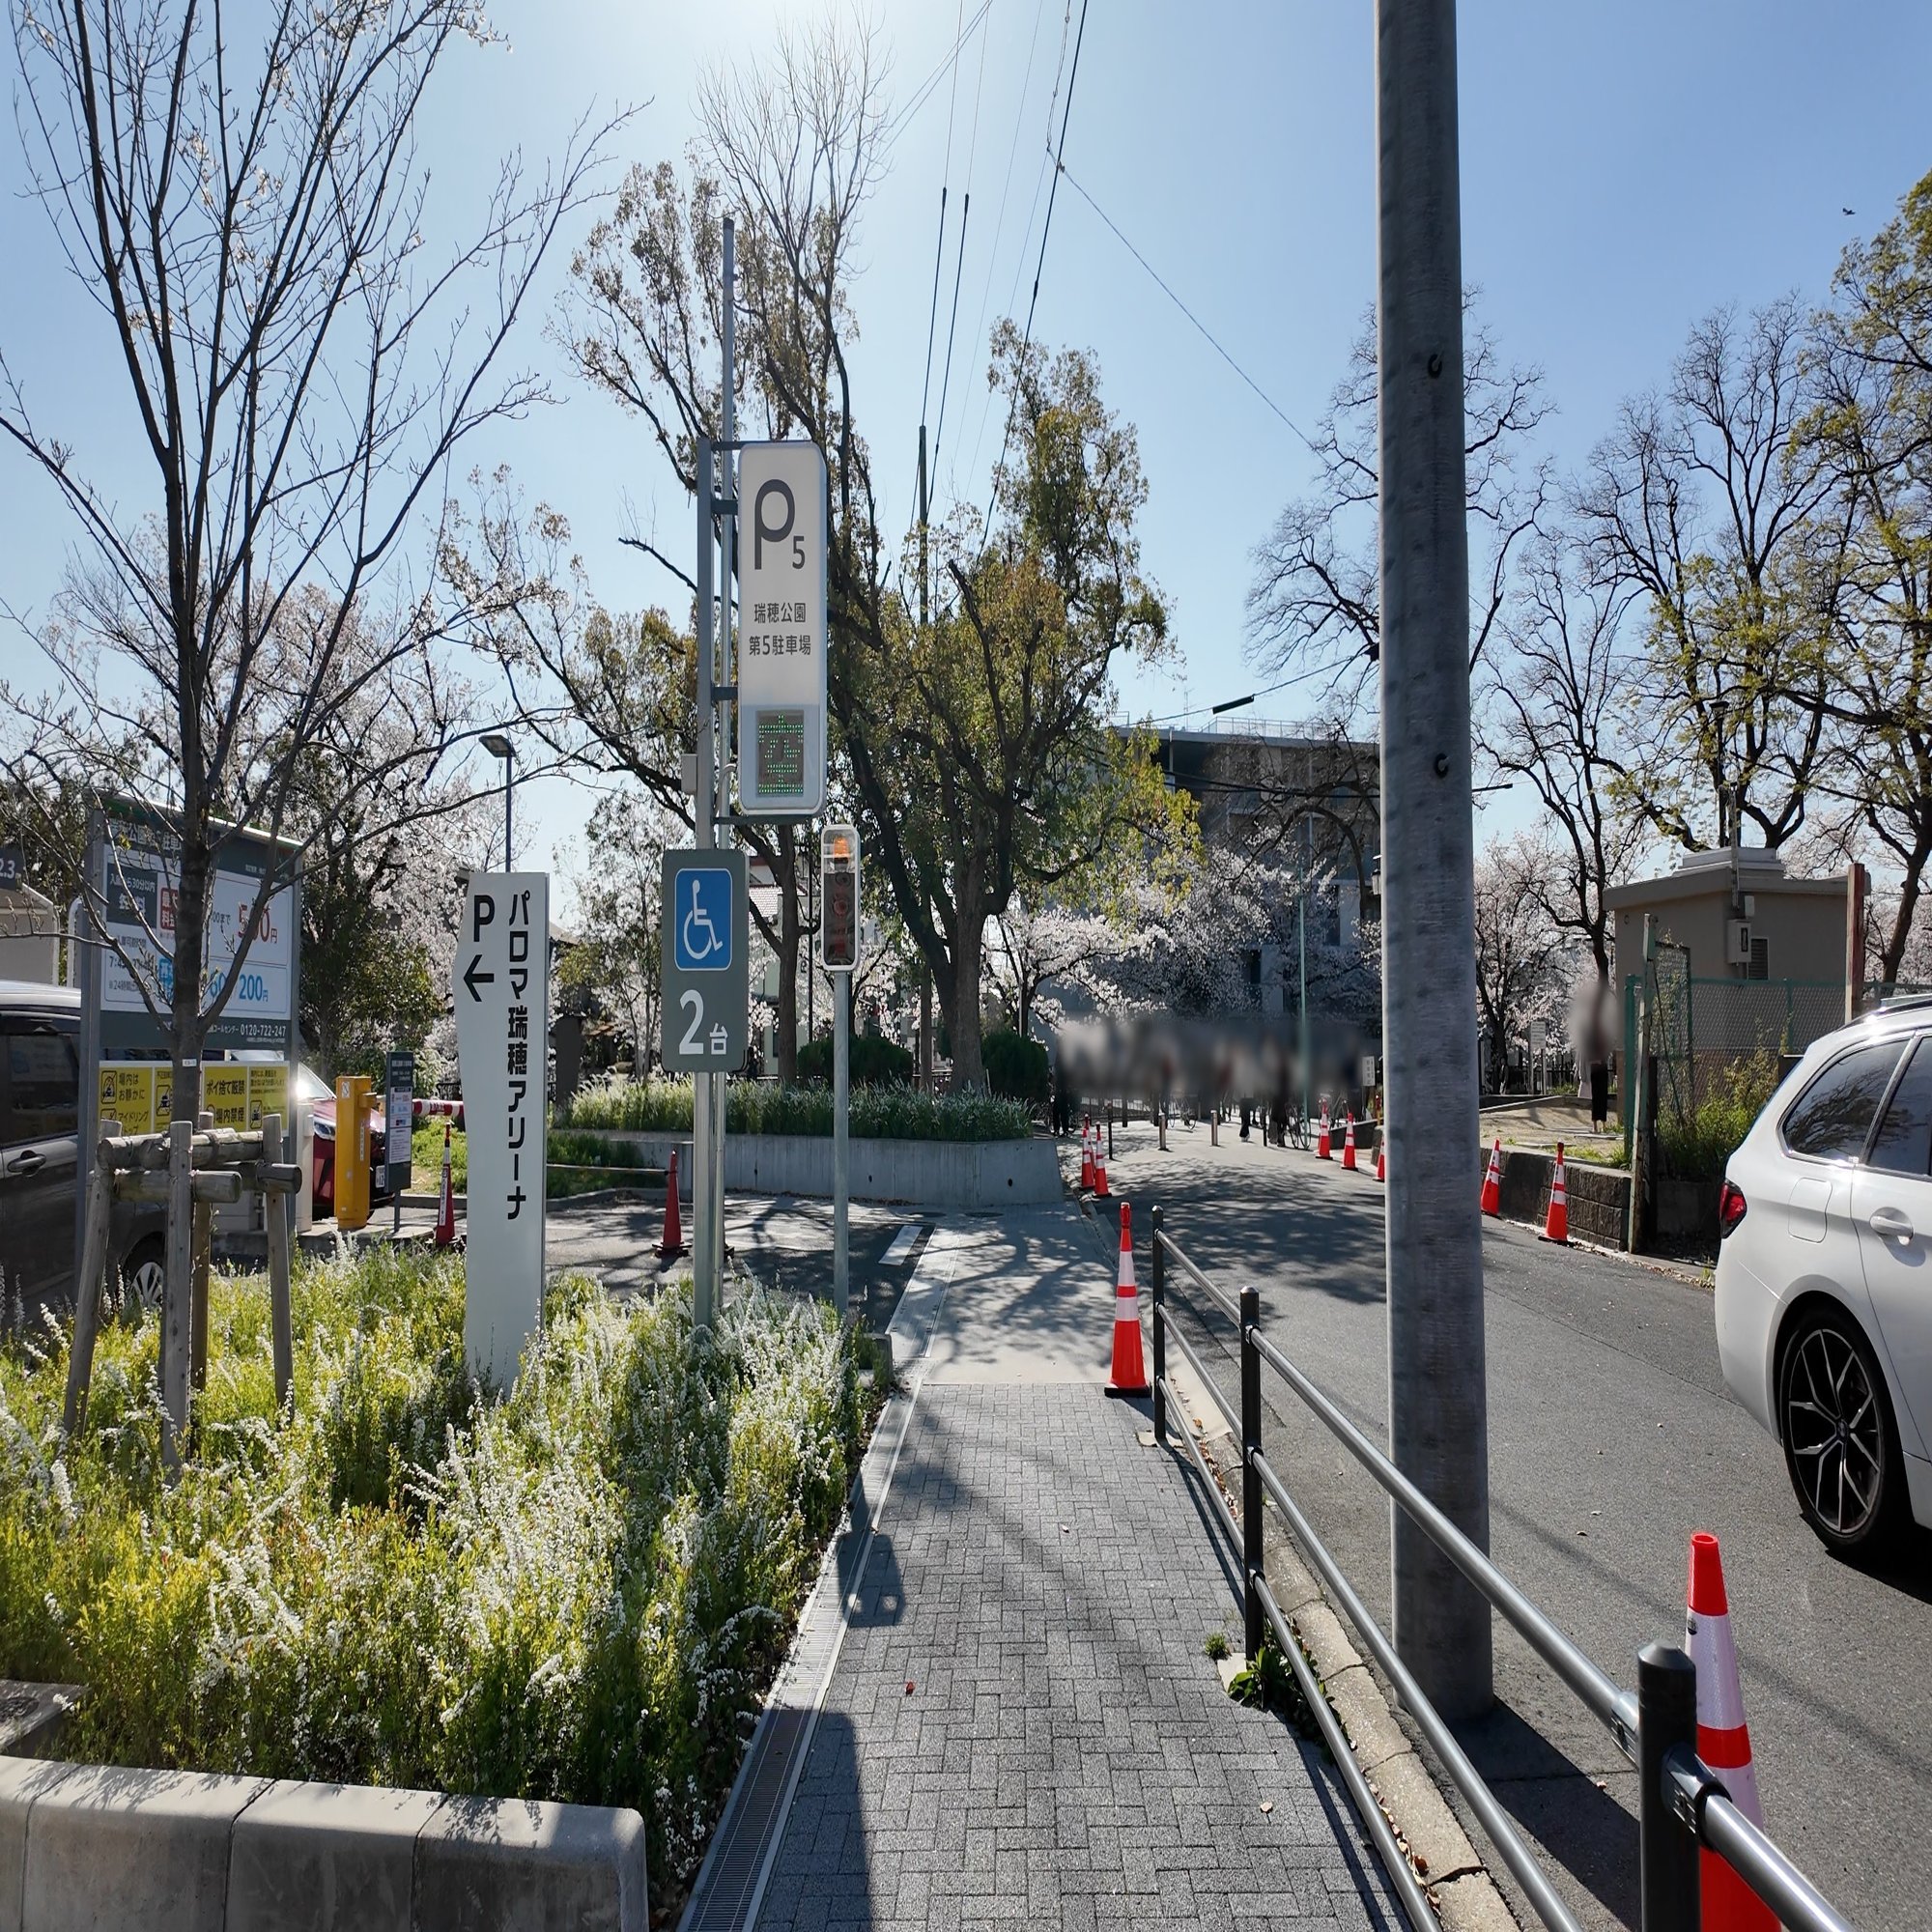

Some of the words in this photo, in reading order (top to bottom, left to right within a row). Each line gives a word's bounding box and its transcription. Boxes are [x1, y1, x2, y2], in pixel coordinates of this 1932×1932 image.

[753, 602, 807, 624] 瑞穂公園
[749, 635, 811, 657] 第5駐車場
[473, 895, 496, 942] P
[239, 974, 269, 1002] 200円
[240, 1024, 287, 1037] 0120-722-247
[679, 989, 728, 1055] 2台
[507, 890, 530, 1220] パロマ瑞穂アリーナ
[206, 1079, 245, 1095] ポイ捨て厳禁
